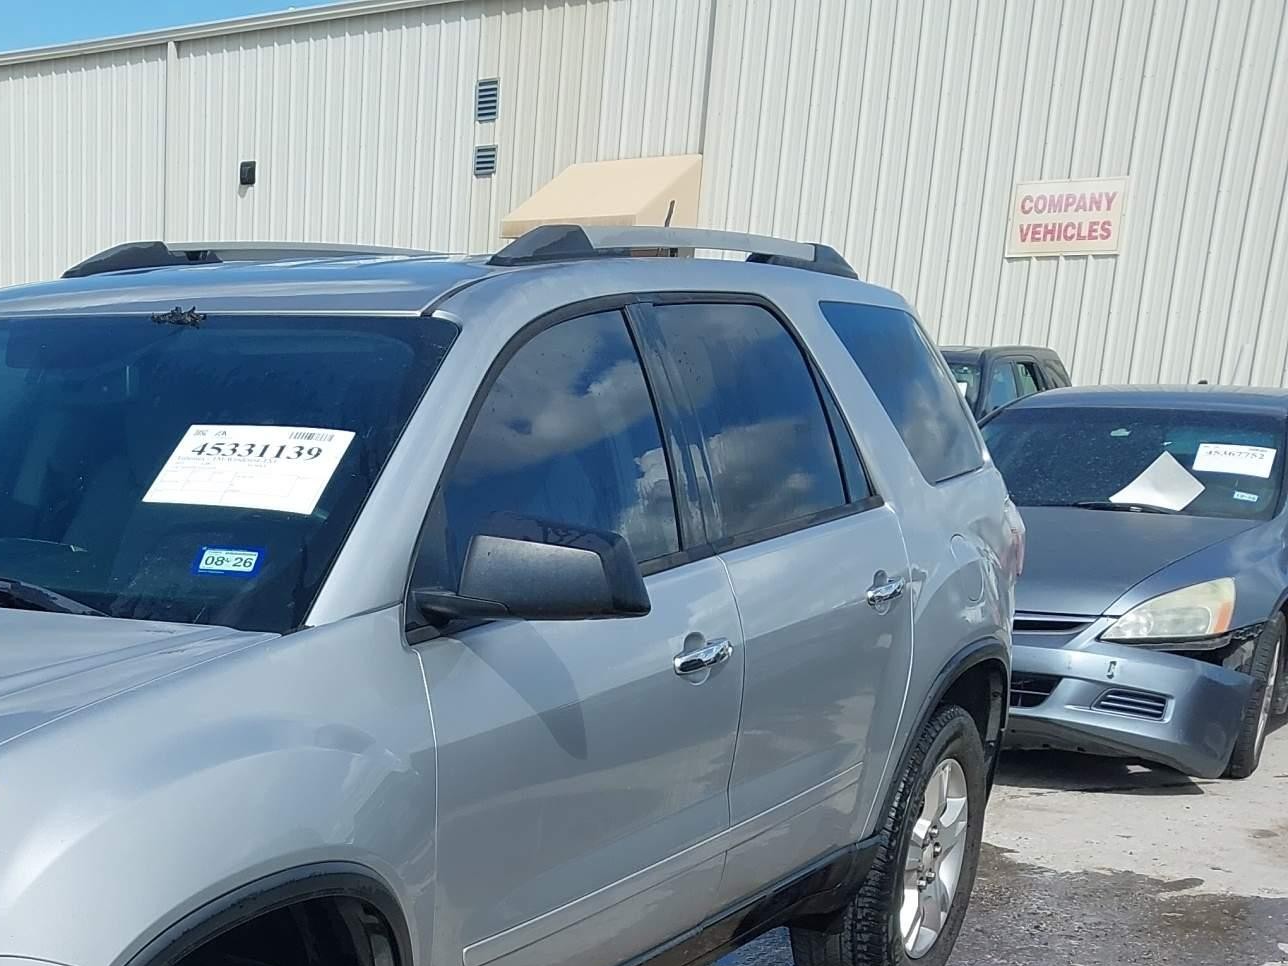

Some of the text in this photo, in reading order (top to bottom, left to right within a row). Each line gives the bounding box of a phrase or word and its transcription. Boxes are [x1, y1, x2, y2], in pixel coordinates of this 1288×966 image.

[1020, 191, 1118, 215] COMPANY
[1018, 220, 1113, 243] VEHICLES
[191, 442, 323, 462] 45331139
[205, 555, 253, 568] 08 26
